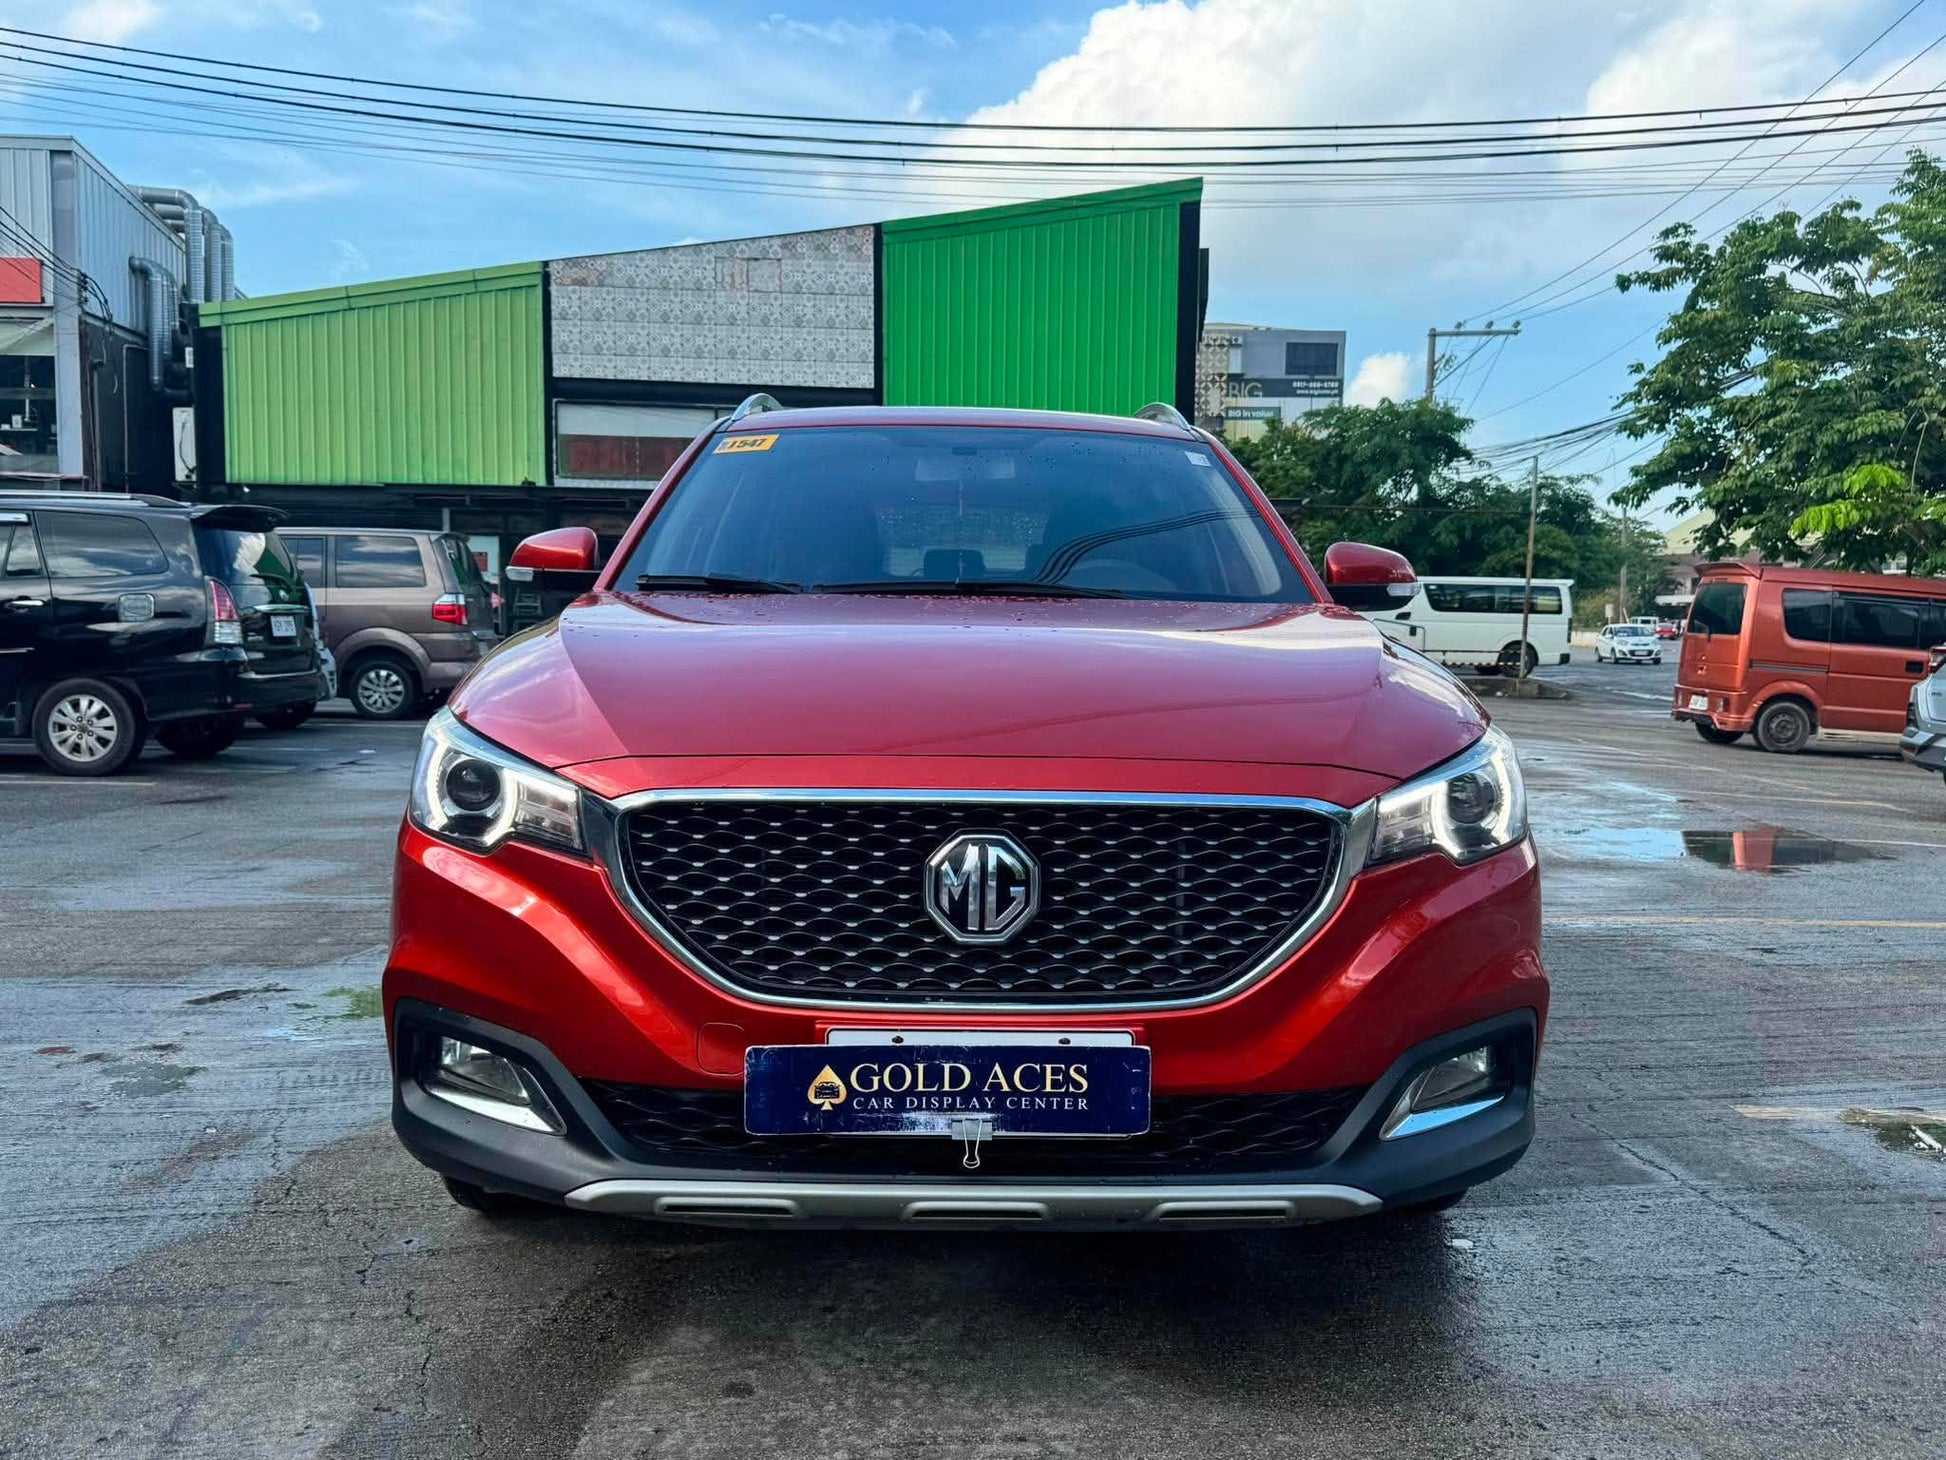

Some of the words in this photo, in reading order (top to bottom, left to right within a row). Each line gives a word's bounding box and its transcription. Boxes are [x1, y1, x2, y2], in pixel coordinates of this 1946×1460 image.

[1228, 382, 1263, 398] BIG
[1228, 410, 1241, 418] BIG
[940, 842, 1026, 931] MG
[850, 1062, 971, 1093] GOLD
[982, 1062, 1089, 1093] ACES
[853, 1097, 894, 1110] CAR
[906, 1096, 996, 1109] DISPLAY
[1006, 1097, 1089, 1110] CENTER
